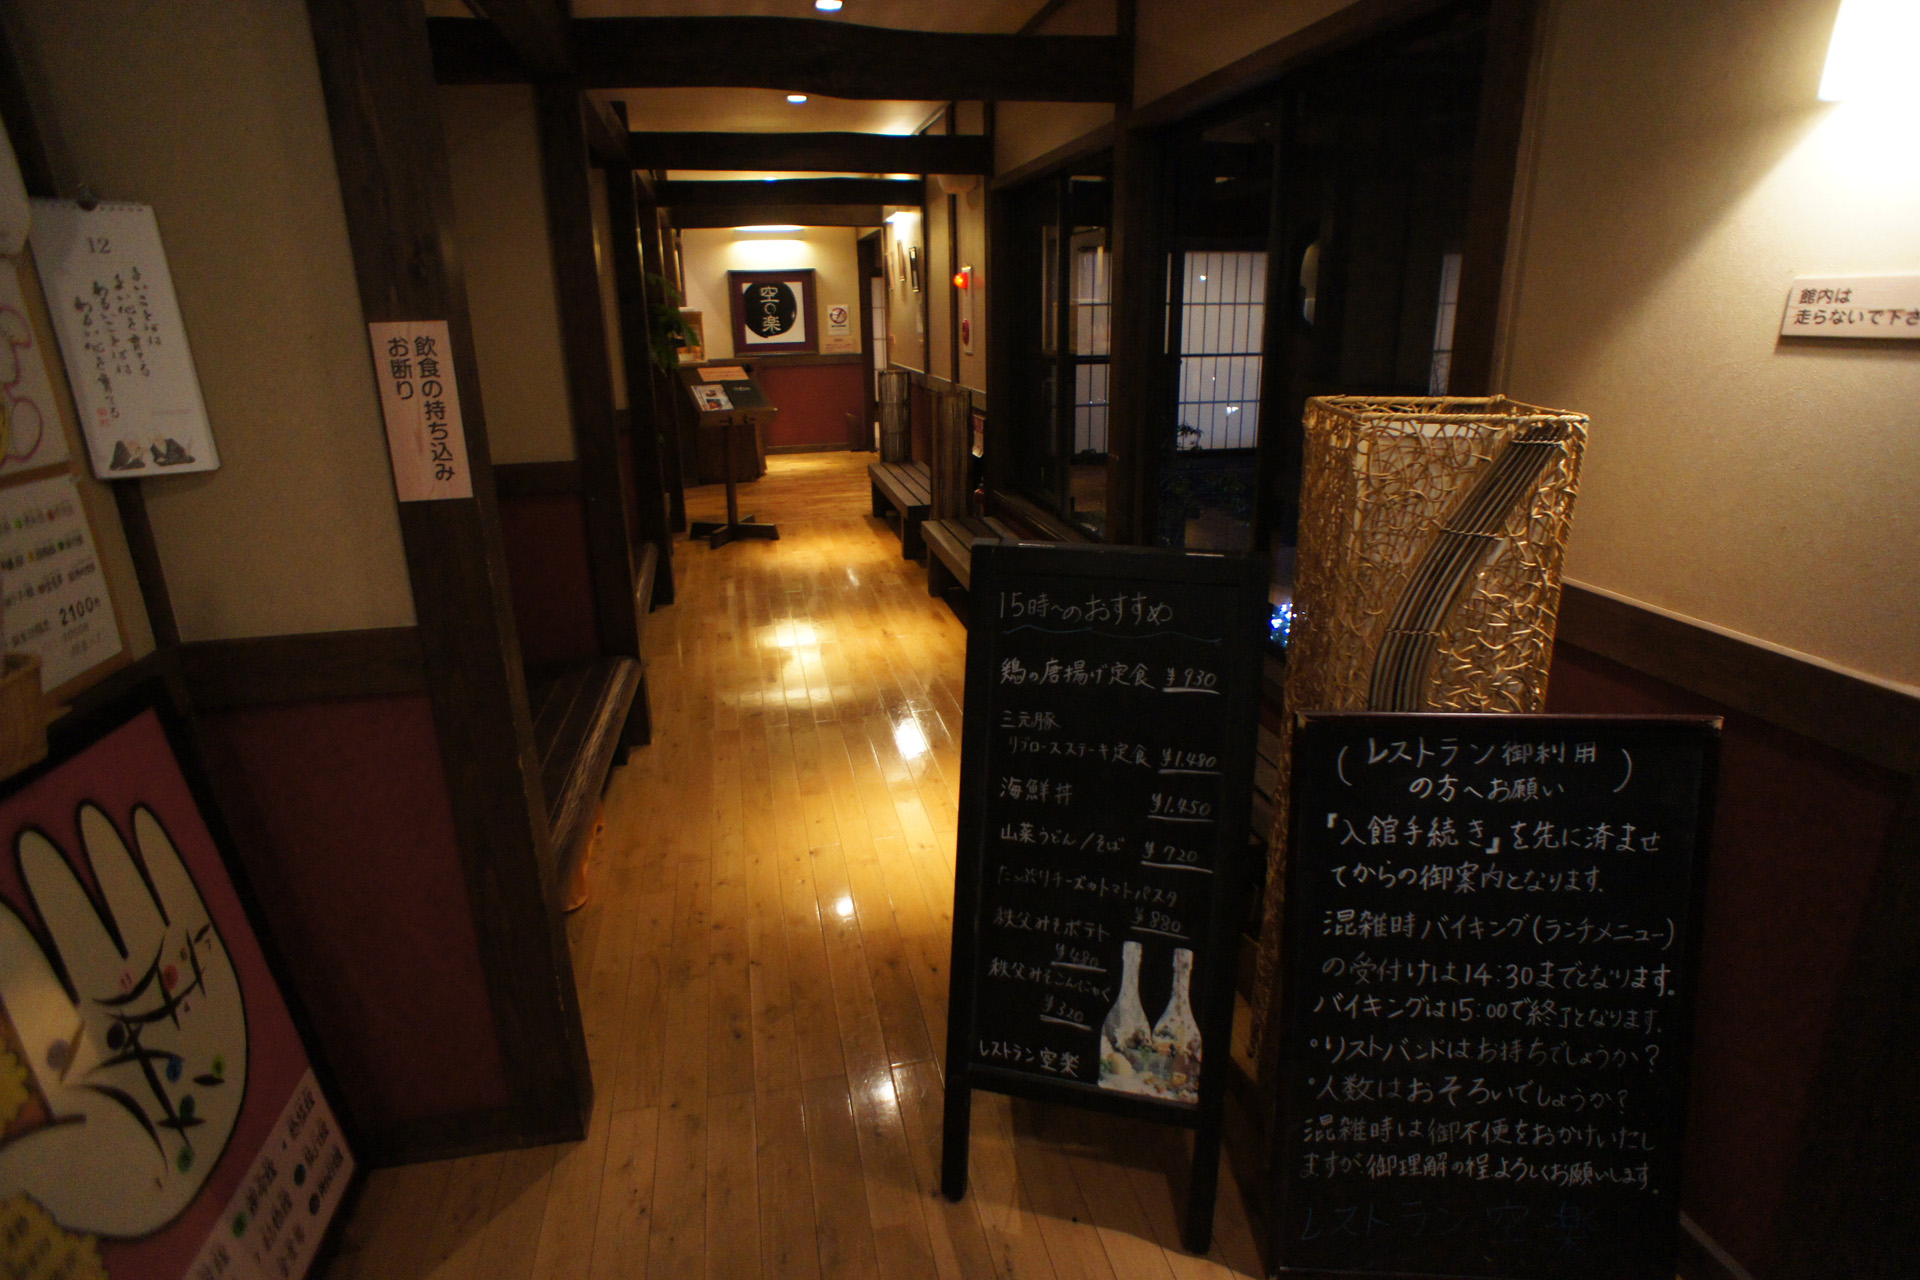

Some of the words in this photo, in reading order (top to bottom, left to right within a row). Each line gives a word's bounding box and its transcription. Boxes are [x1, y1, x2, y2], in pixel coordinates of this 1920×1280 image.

[88, 237, 111, 254] 12
[1799, 288, 1852, 305] 館内は
[387, 337, 415, 400] お断り
[414, 335, 456, 482] 飲食の持ち込み
[1000, 656, 1155, 690] 鶏の唐揚げ定食
[1000, 711, 1061, 730] 三元豚
[1000, 776, 1073, 805] 海鮮丼
